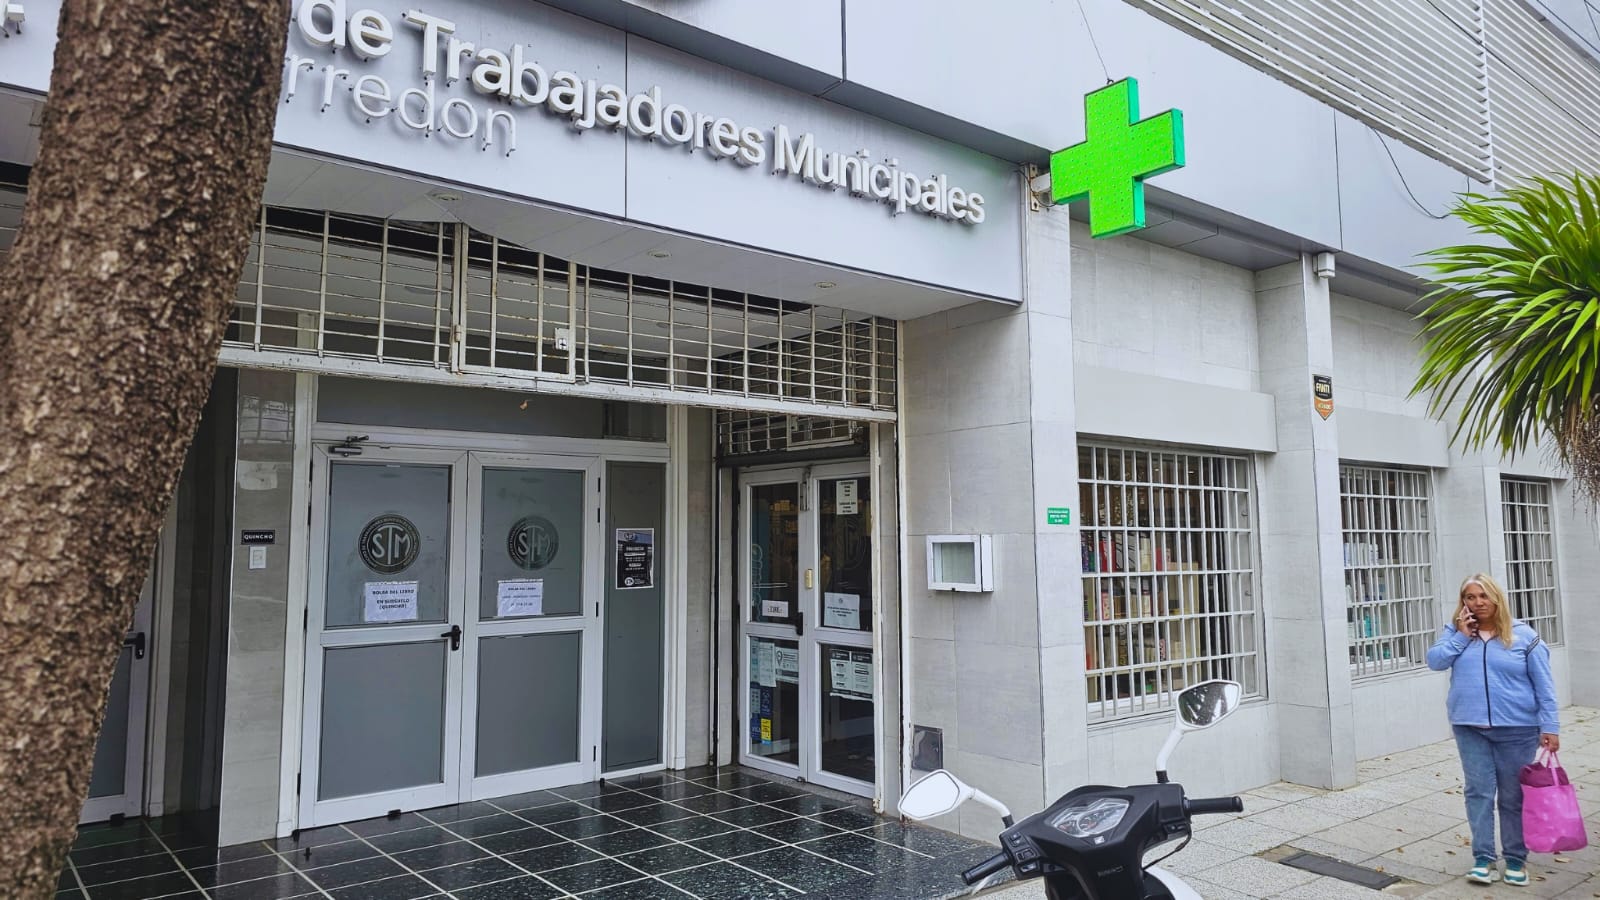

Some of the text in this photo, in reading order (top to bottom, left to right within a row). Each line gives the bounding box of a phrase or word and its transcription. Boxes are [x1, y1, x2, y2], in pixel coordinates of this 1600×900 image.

[297, 0, 986, 225] de Trabajadores Municipales
[371, 524, 411, 565] STM
[517, 525, 551, 562] STM
